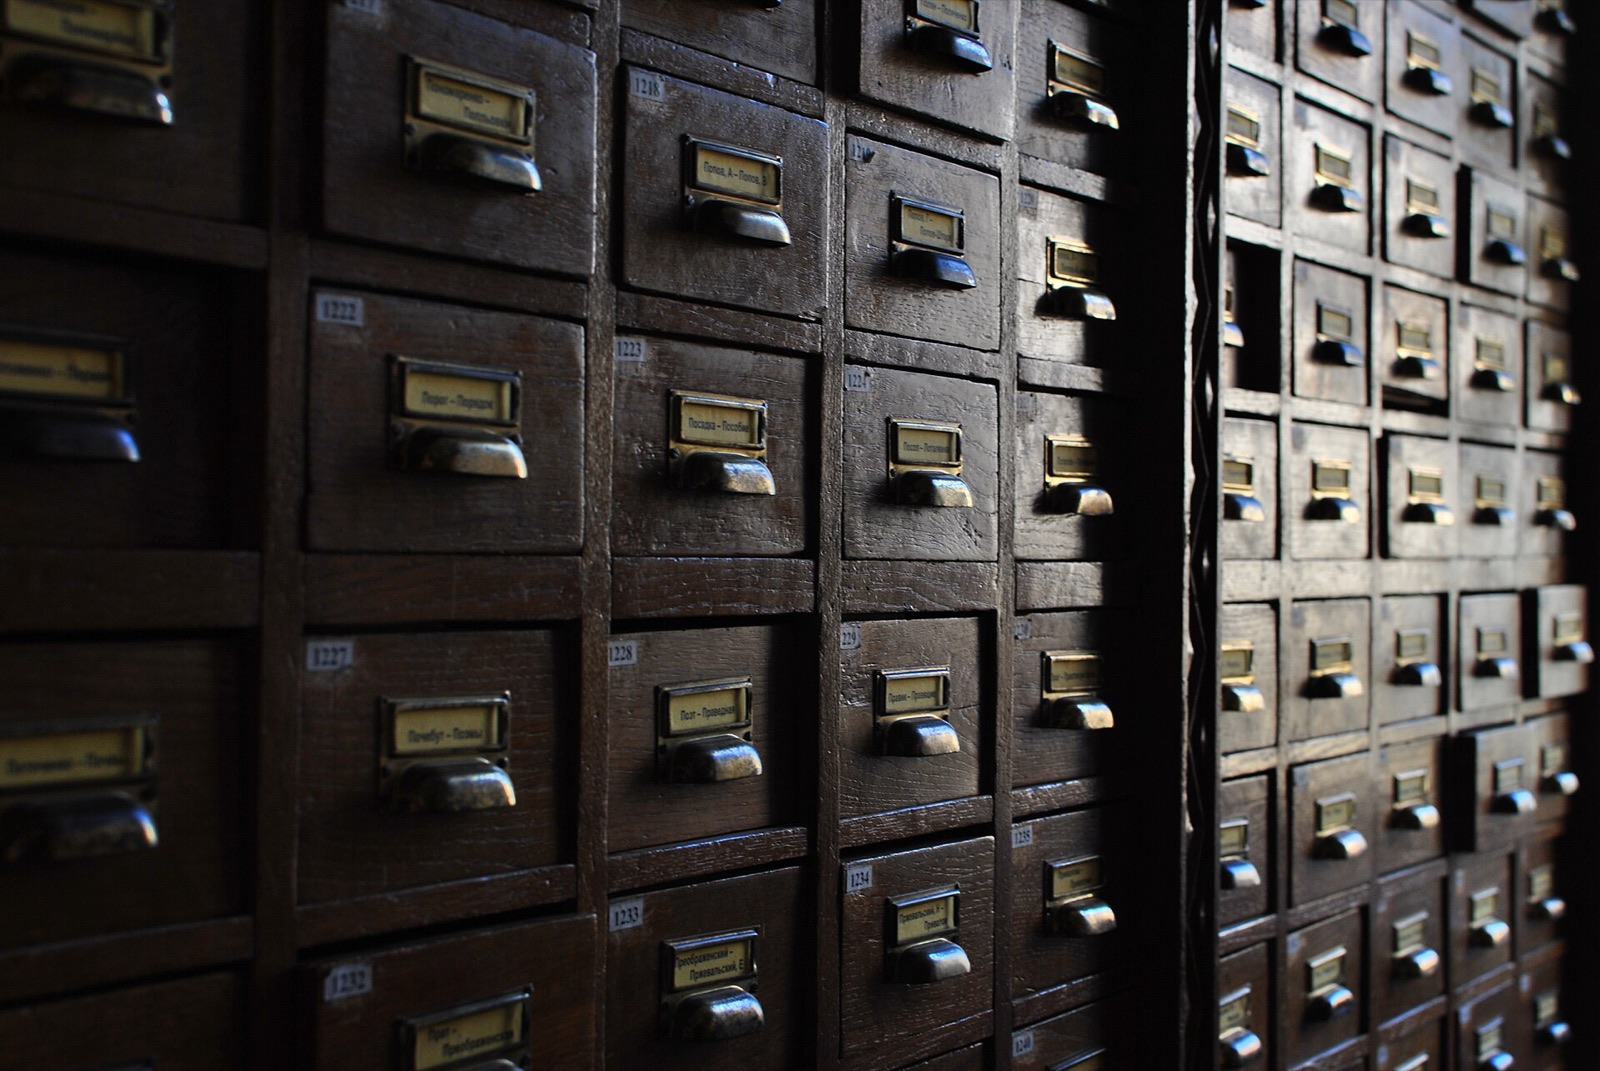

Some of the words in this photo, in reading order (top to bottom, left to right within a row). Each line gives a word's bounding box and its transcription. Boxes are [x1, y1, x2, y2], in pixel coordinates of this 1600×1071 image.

[635, 77, 661, 98] 1218
[324, 301, 356, 321] 1222
[617, 341, 641, 358] 1223
[689, 417, 715, 431] Посадка
[314, 647, 347, 667] 1227
[609, 645, 632, 662] 1228
[681, 710, 696, 721] Поэт
[851, 871, 870, 888] 1234
[615, 906, 639, 926] 1233
[332, 970, 366, 995] 1232
